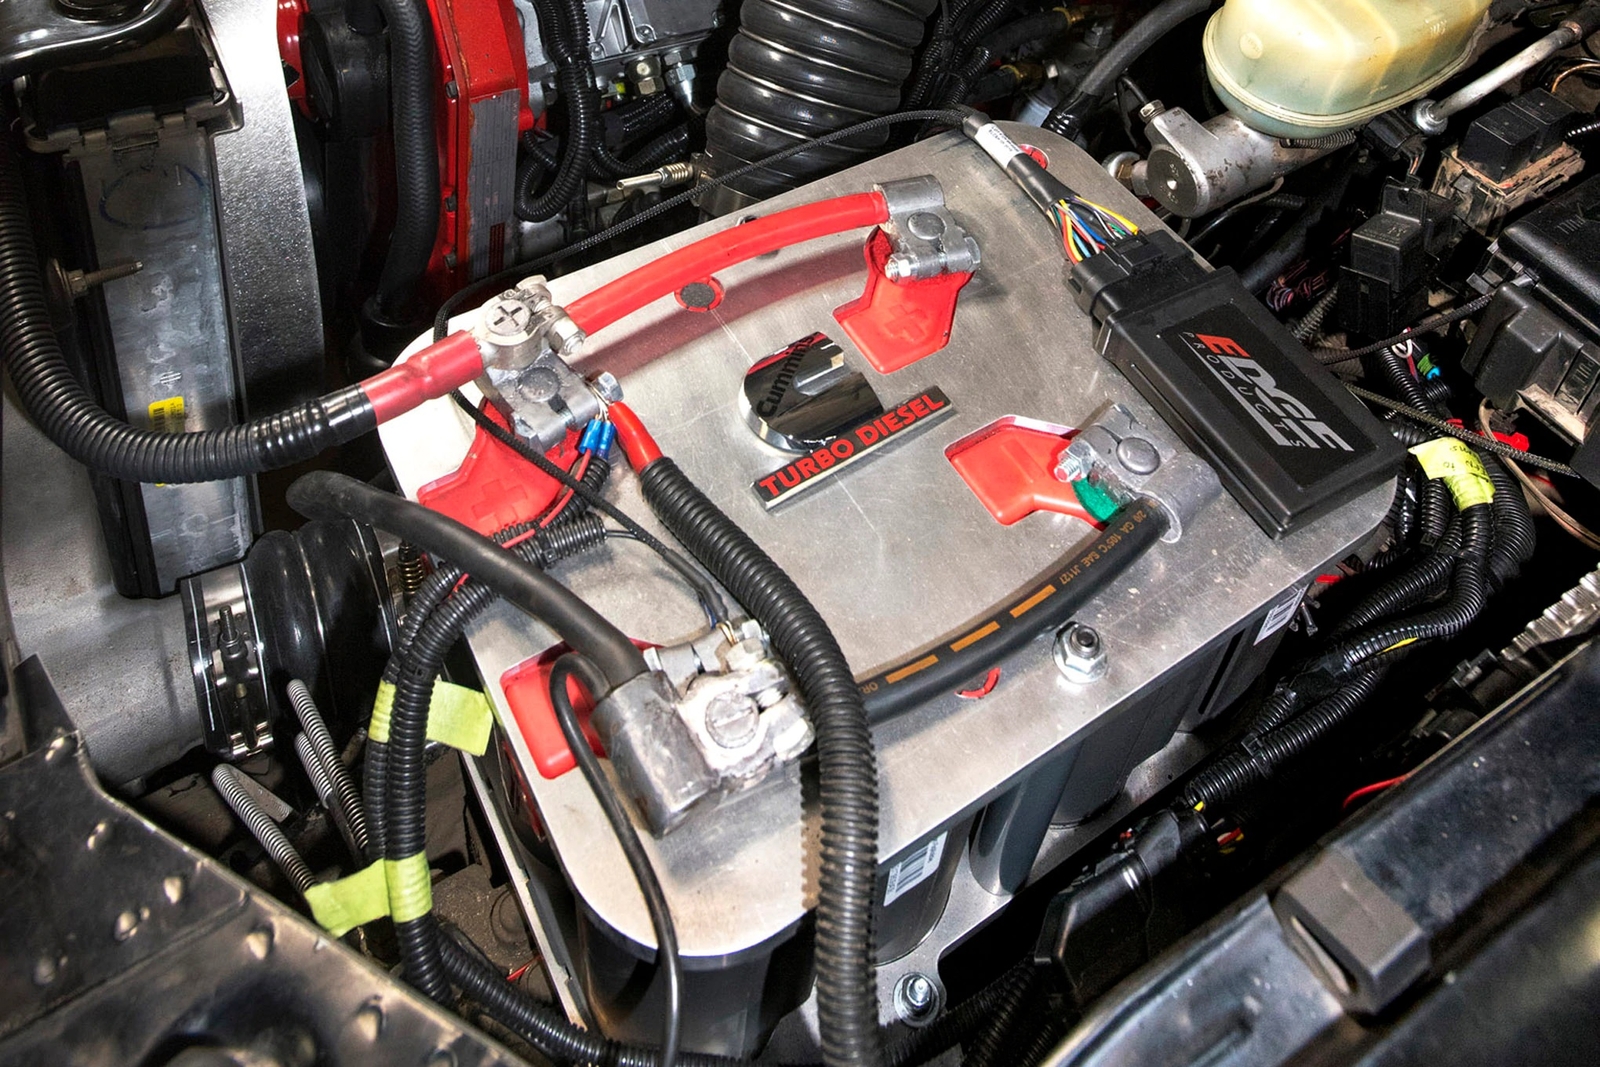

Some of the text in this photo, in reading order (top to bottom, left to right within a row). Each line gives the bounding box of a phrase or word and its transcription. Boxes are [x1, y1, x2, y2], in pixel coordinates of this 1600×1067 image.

[756, 336, 816, 418] Cummins
[1183, 331, 1306, 448] PRODUCTS
[1194, 333, 1355, 451] EDGE
[759, 394, 944, 497] TURBO DIESEL
[1081, 551, 1100, 567] SAE
[1120, 521, 1135, 534] GA
[1059, 564, 1081, 585] J1127
